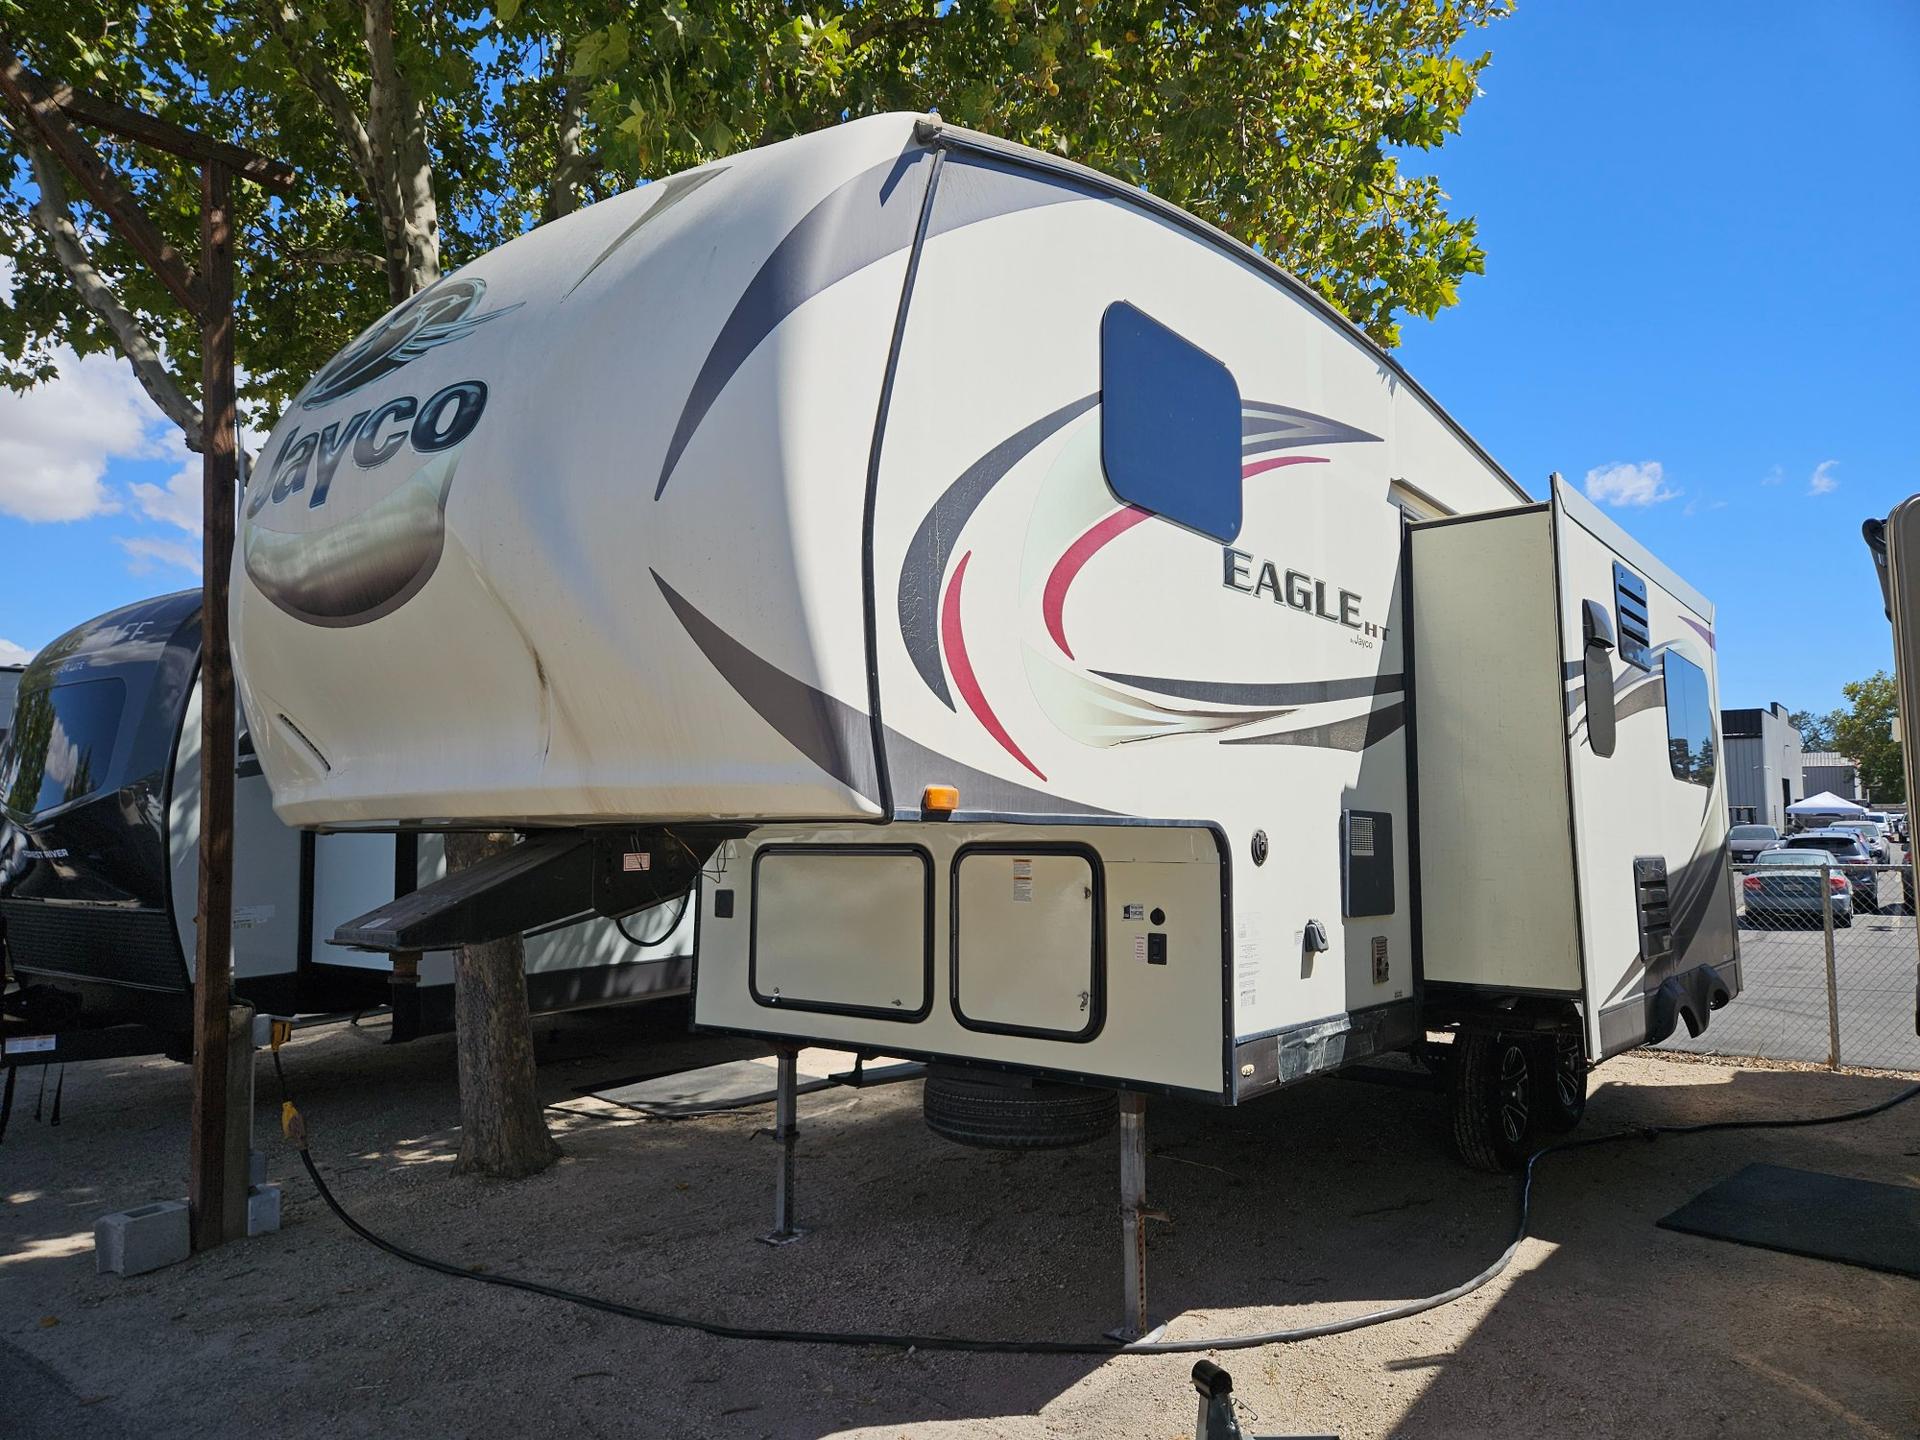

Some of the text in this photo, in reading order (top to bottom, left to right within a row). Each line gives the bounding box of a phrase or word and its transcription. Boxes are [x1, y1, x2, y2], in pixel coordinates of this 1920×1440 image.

[1222, 547, 1390, 642] EAGLE HT
[43, 848, 69, 858] RIVER
